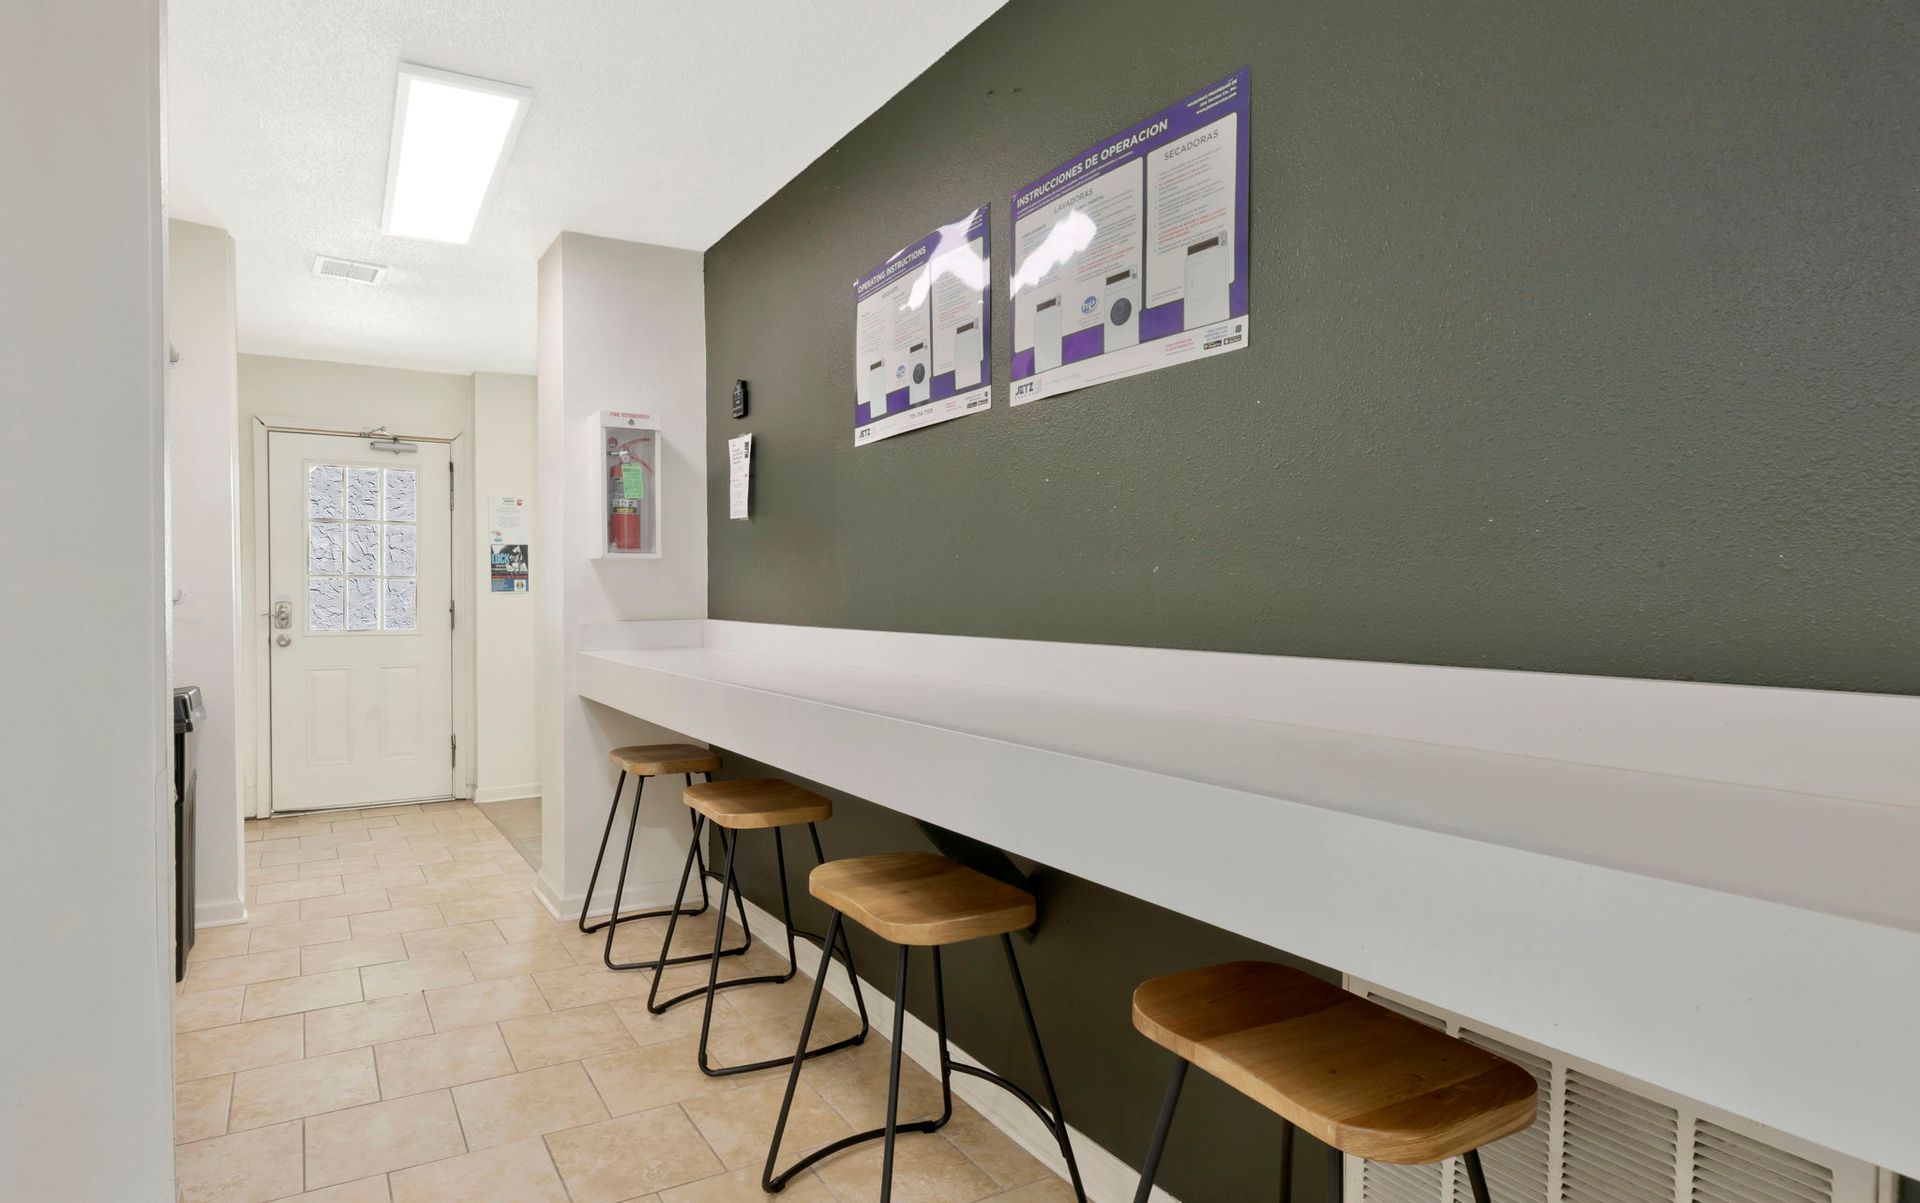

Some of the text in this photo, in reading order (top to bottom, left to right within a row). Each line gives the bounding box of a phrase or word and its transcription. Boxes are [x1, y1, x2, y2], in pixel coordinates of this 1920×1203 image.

[1164, 129, 1219, 160] SECADORAS
[1016, 162, 1083, 208] INSTRUCCIONES
[1084, 153, 1099, 170] DE
[1100, 118, 1168, 161] OPERACION
[1054, 187, 1094, 214] LAVADORAS
[857, 270, 886, 294] OPERATING
[885, 246, 926, 277] INSTRUCTIONS
[1015, 382, 1034, 396] JETZ
[858, 428, 871, 439] JETZ
